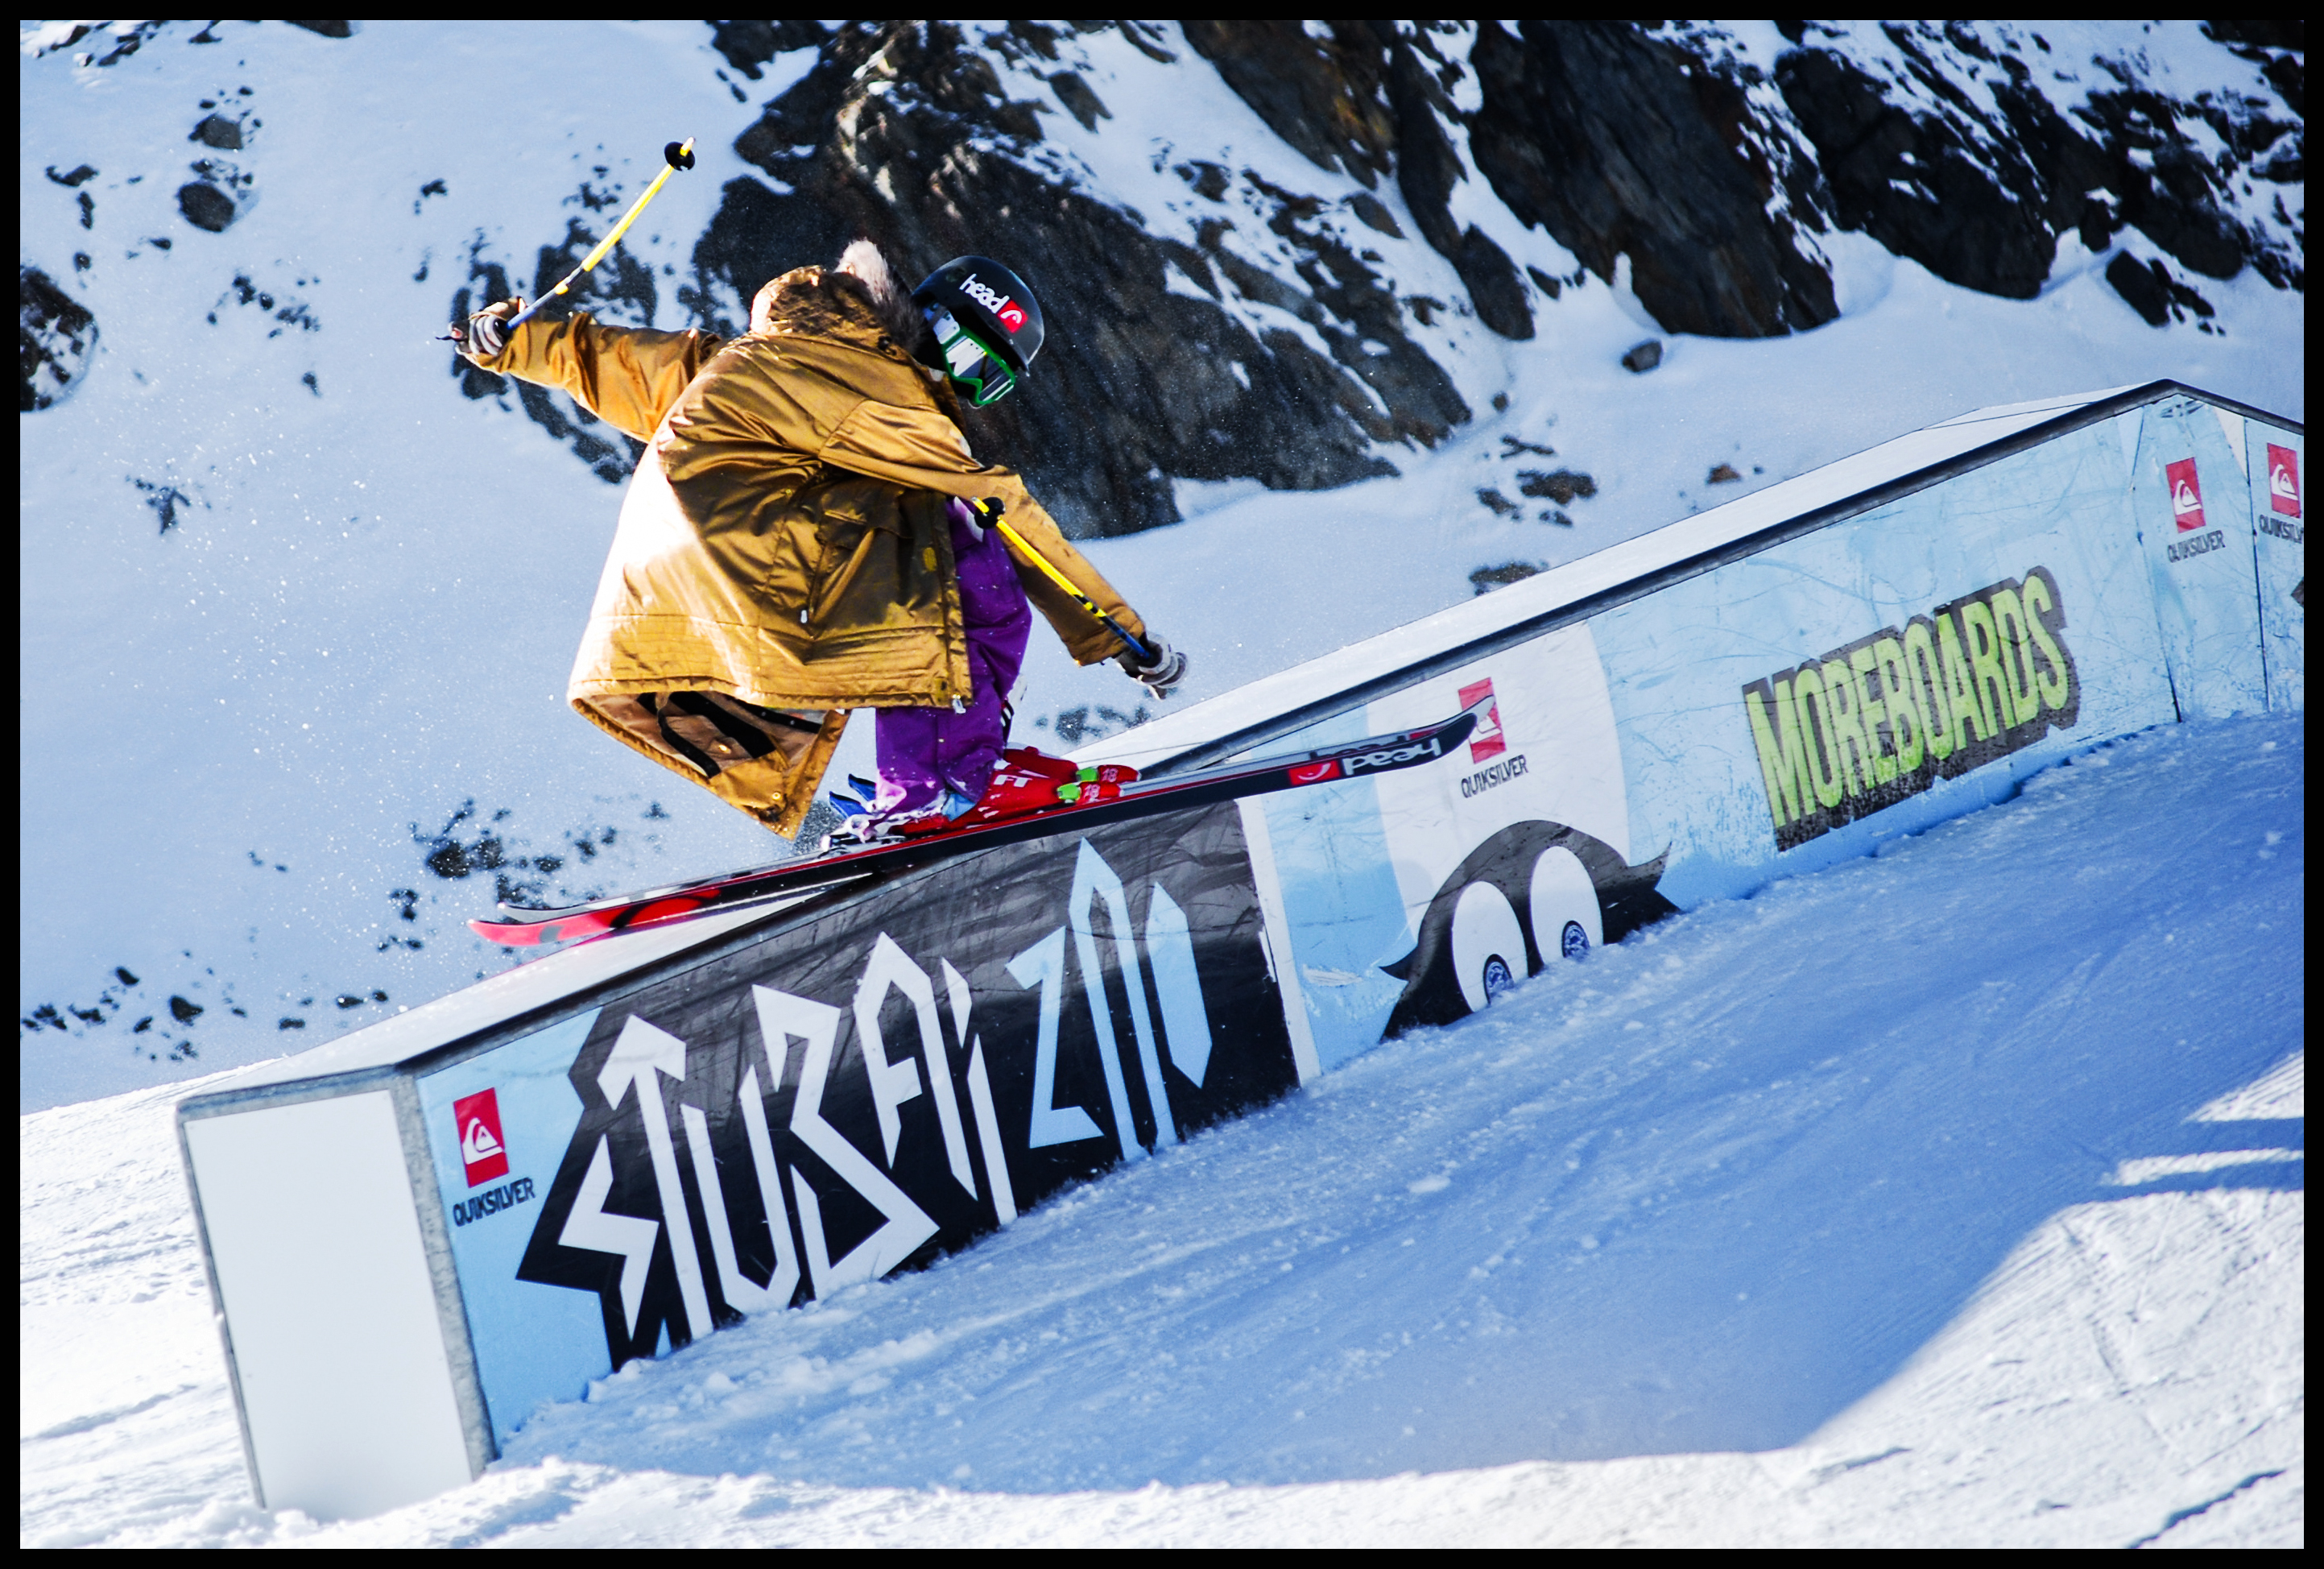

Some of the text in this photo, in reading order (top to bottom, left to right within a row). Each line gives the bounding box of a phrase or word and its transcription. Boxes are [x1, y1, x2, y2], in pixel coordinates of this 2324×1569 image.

[959, 273, 1011, 314] head
[2167, 529, 2227, 564] QUIKSILVER
[1745, 574, 2069, 829] MOREBOARDS
[1342, 737, 1442, 776] head
[1461, 754, 1529, 798] QUIKSILVER
[453, 1177, 536, 1227] QUIKSILVER
